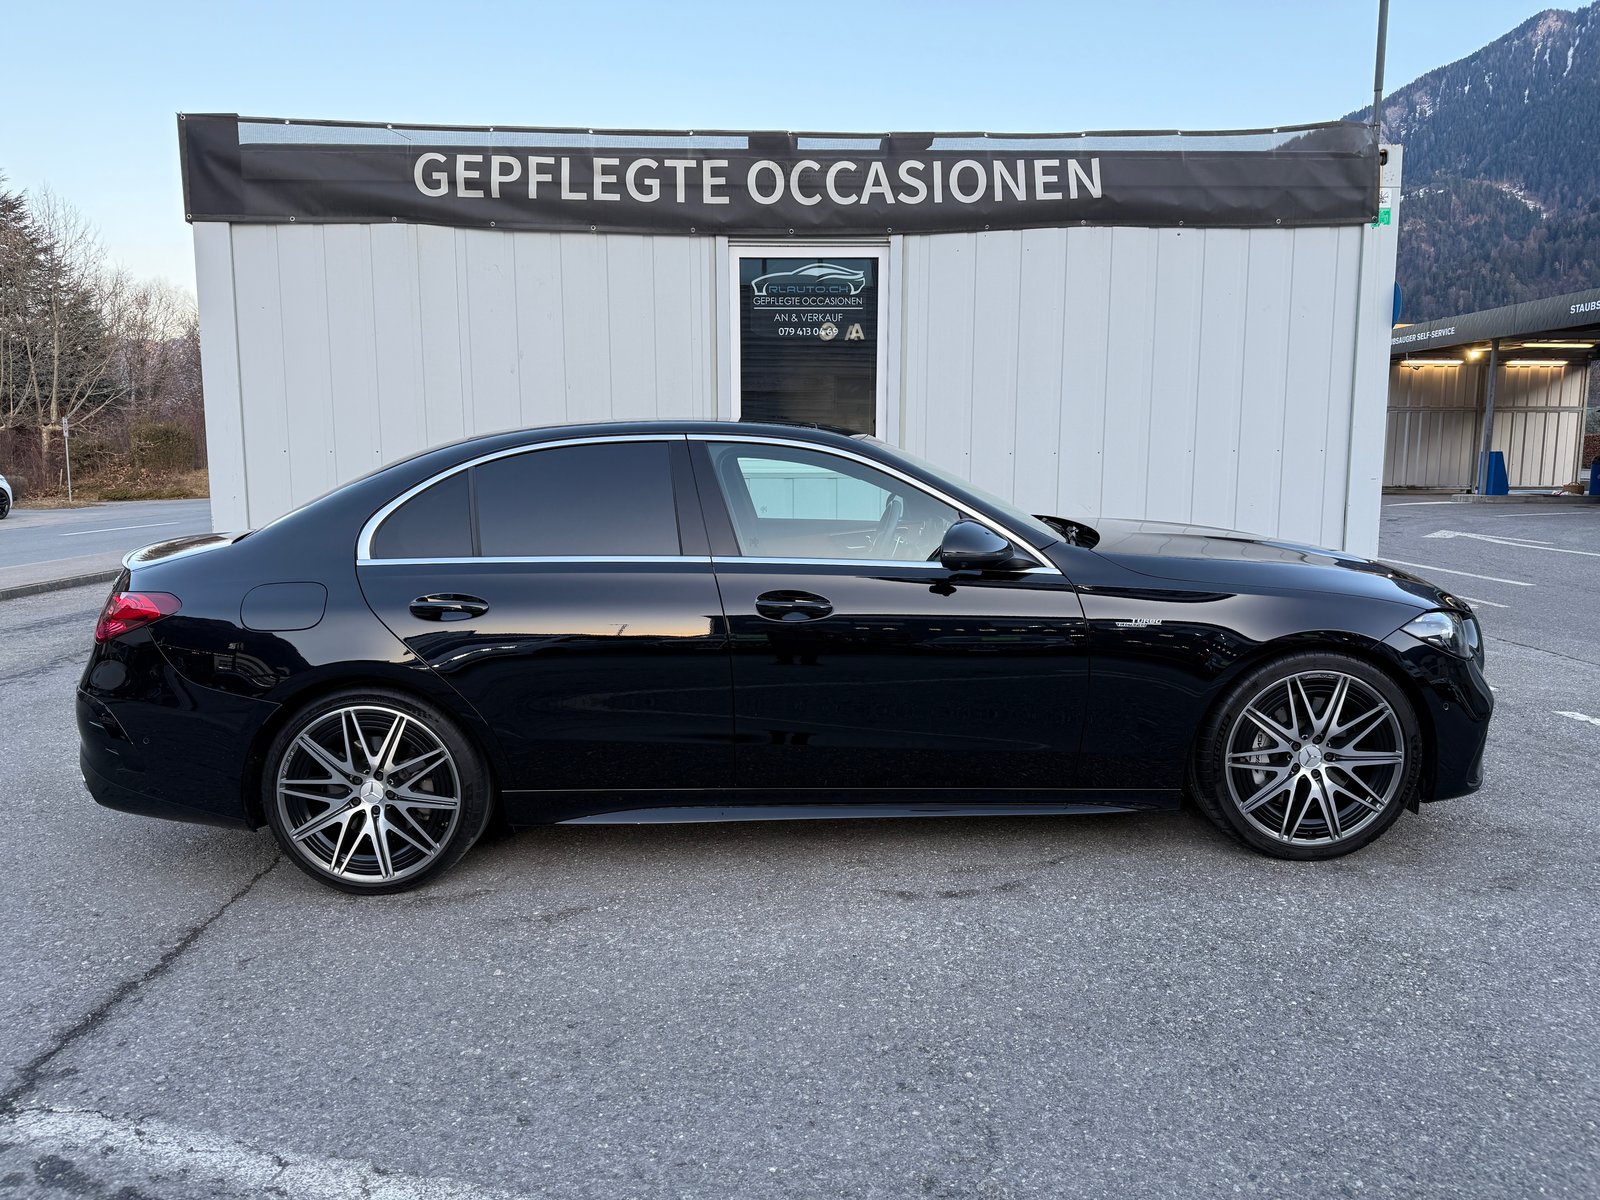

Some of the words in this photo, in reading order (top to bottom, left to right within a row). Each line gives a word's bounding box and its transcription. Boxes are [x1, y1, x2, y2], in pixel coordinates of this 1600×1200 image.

[413, 152, 730, 205] GEPFLEGTE
[746, 157, 1103, 206] OCCASIONEN
[769, 285, 848, 293] RLAUTO.CH
[753, 297, 800, 305] GEPFLEGTE
[802, 297, 863, 305] OCCASIONEN
[1569, 300, 1600, 314] STAUBS
[774, 313, 789, 322] AN
[791, 313, 799, 322] &
[801, 313, 843, 322] VERKAUF
[778, 327, 795, 336] 079
[796, 327, 811, 336] 413
[826, 327, 839, 336] 69
[1417, 326, 1456, 341] SELF-SERVICE
